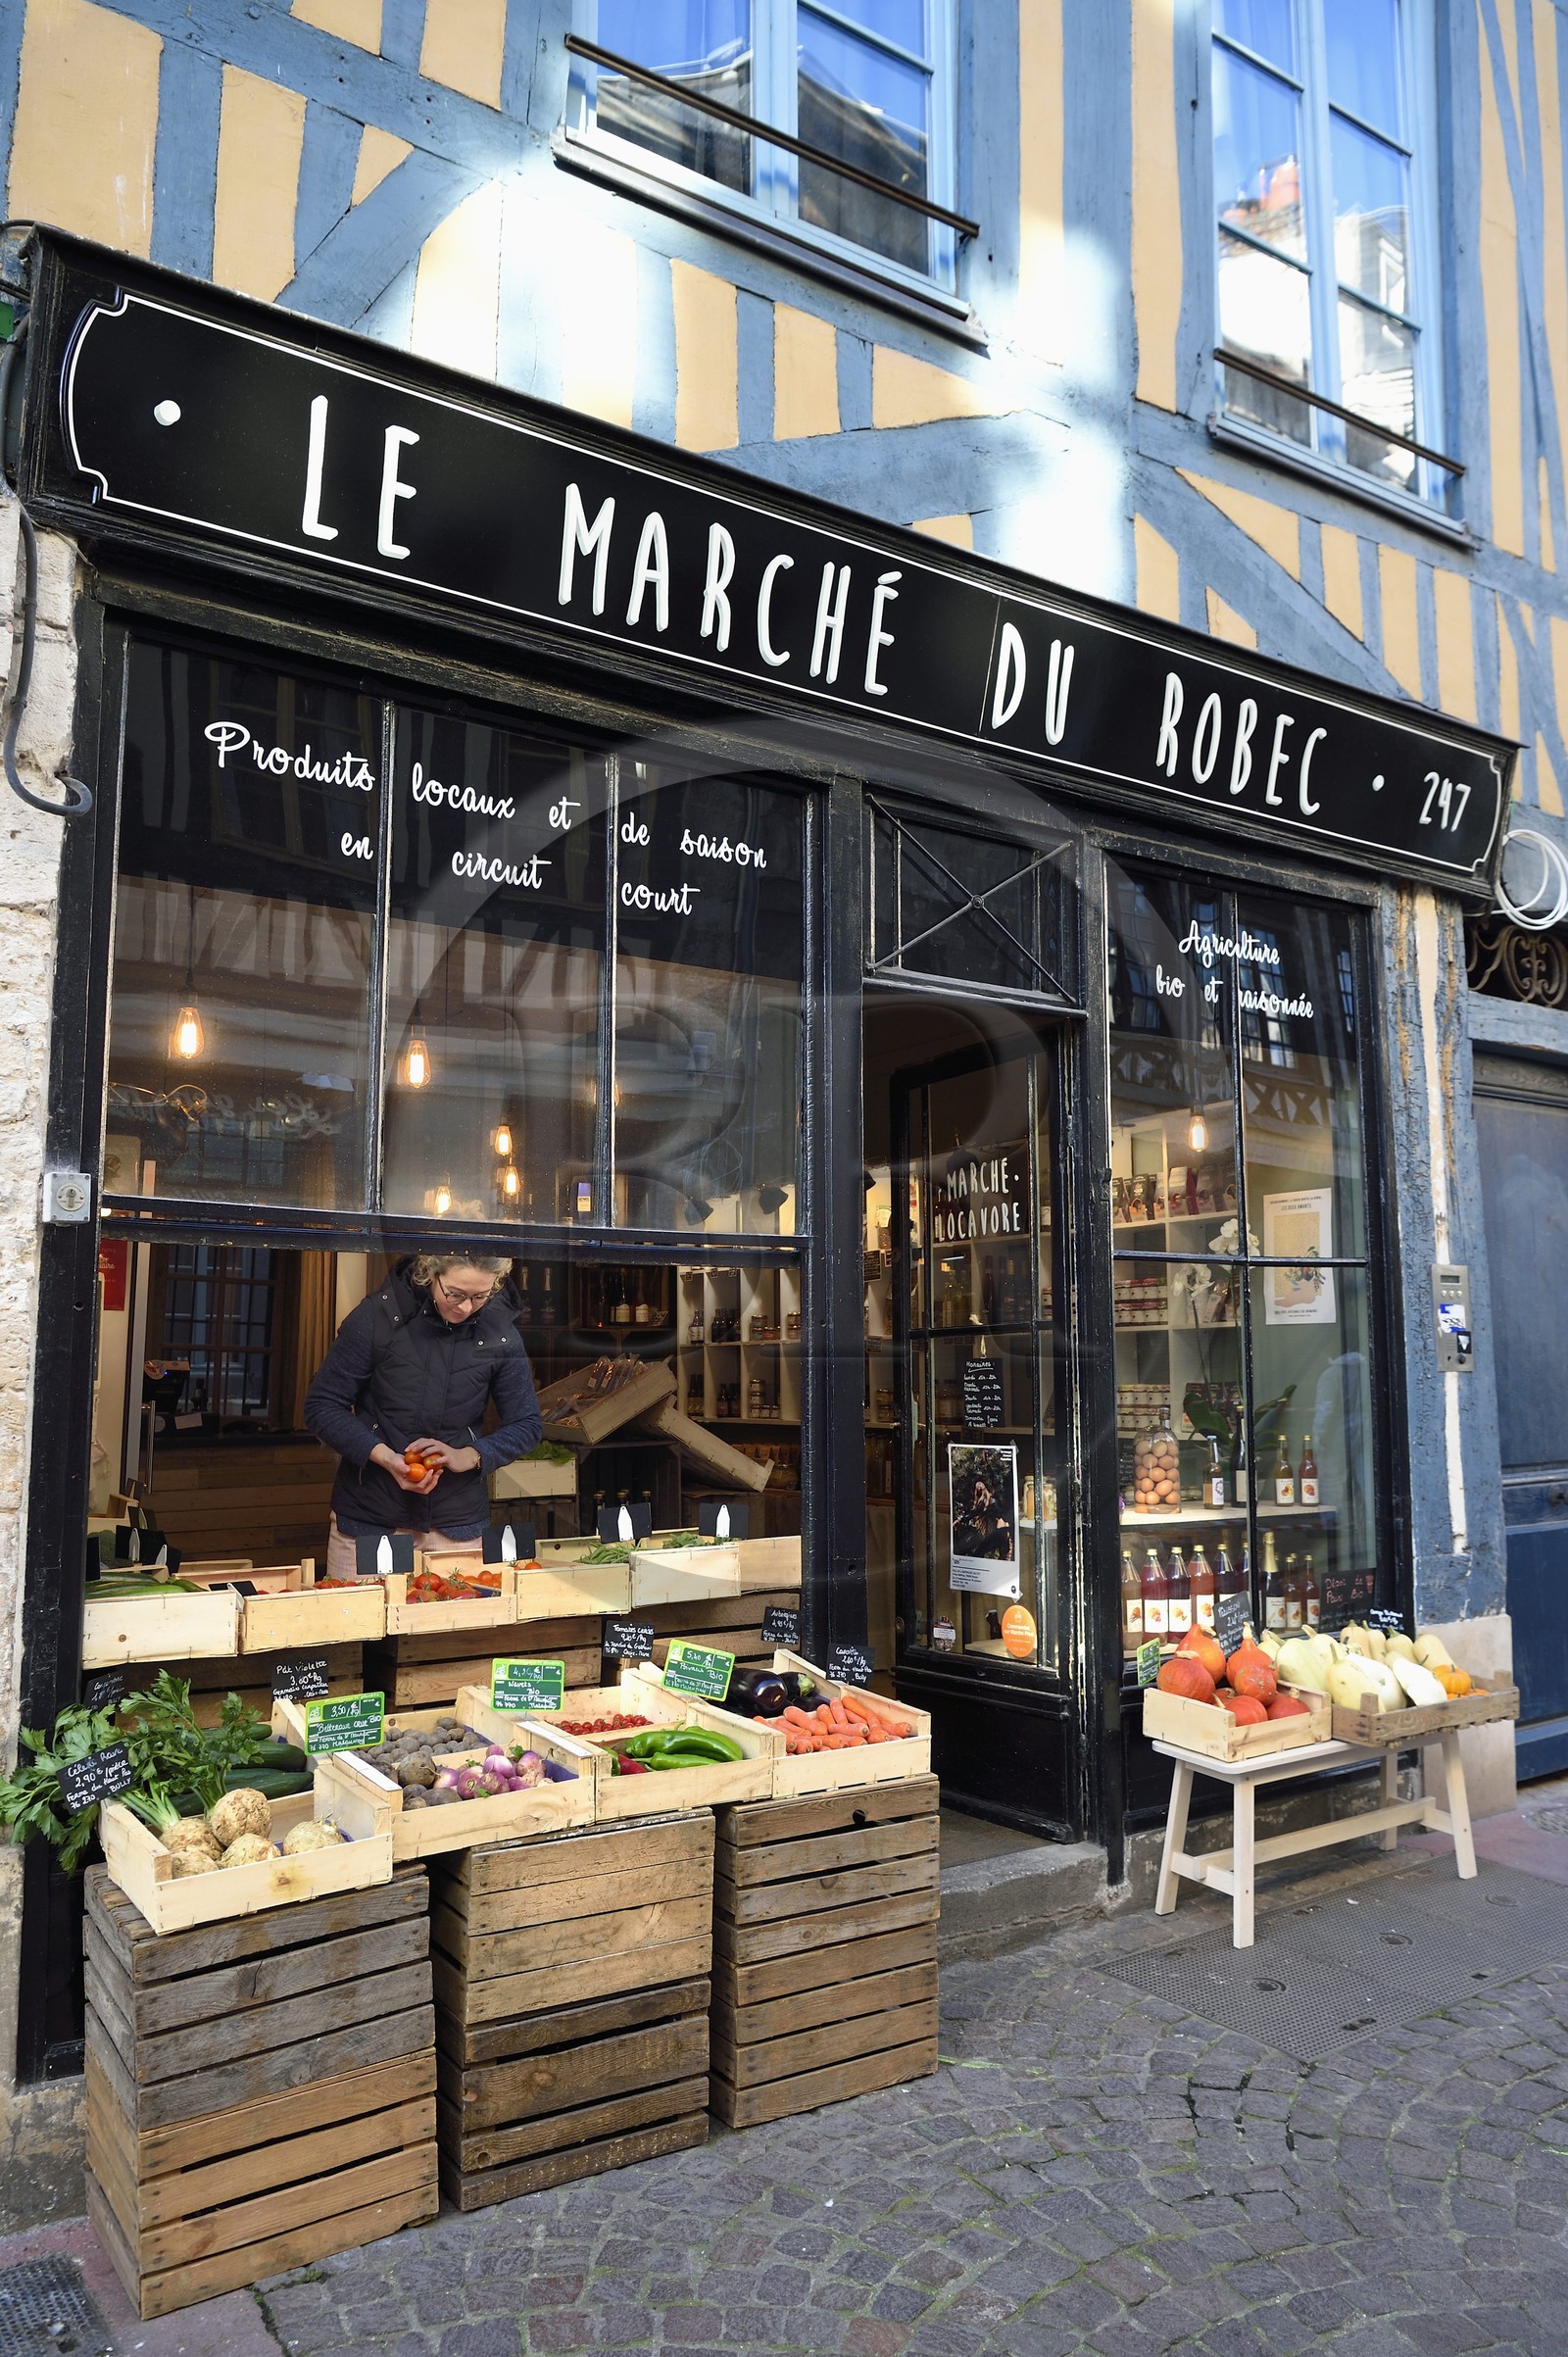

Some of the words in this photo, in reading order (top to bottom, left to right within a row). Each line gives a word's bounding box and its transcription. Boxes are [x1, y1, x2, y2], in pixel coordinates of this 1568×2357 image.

[302, 394, 420, 560] LE
[558, 482, 903, 696] MARCHÉ
[991, 621, 1075, 746] DU
[1155, 671, 1328, 815] ROBEC
[1419, 771, 1472, 832] 247
[204, 721, 375, 792] Produits
[412, 761, 515, 819] locaux
[549, 796, 582, 830] et
[620, 811, 651, 846] de
[680, 829, 767, 868] saison
[341, 832, 373, 859] en
[451, 851, 552, 889] circuit
[620, 882, 701, 915] court
[1155, 963, 1186, 998] bio
[1204, 975, 1224, 1004] et
[947, 1157, 1009, 1203] MARCHÉ
[938, 1202, 1020, 1242] LOCAVORE
